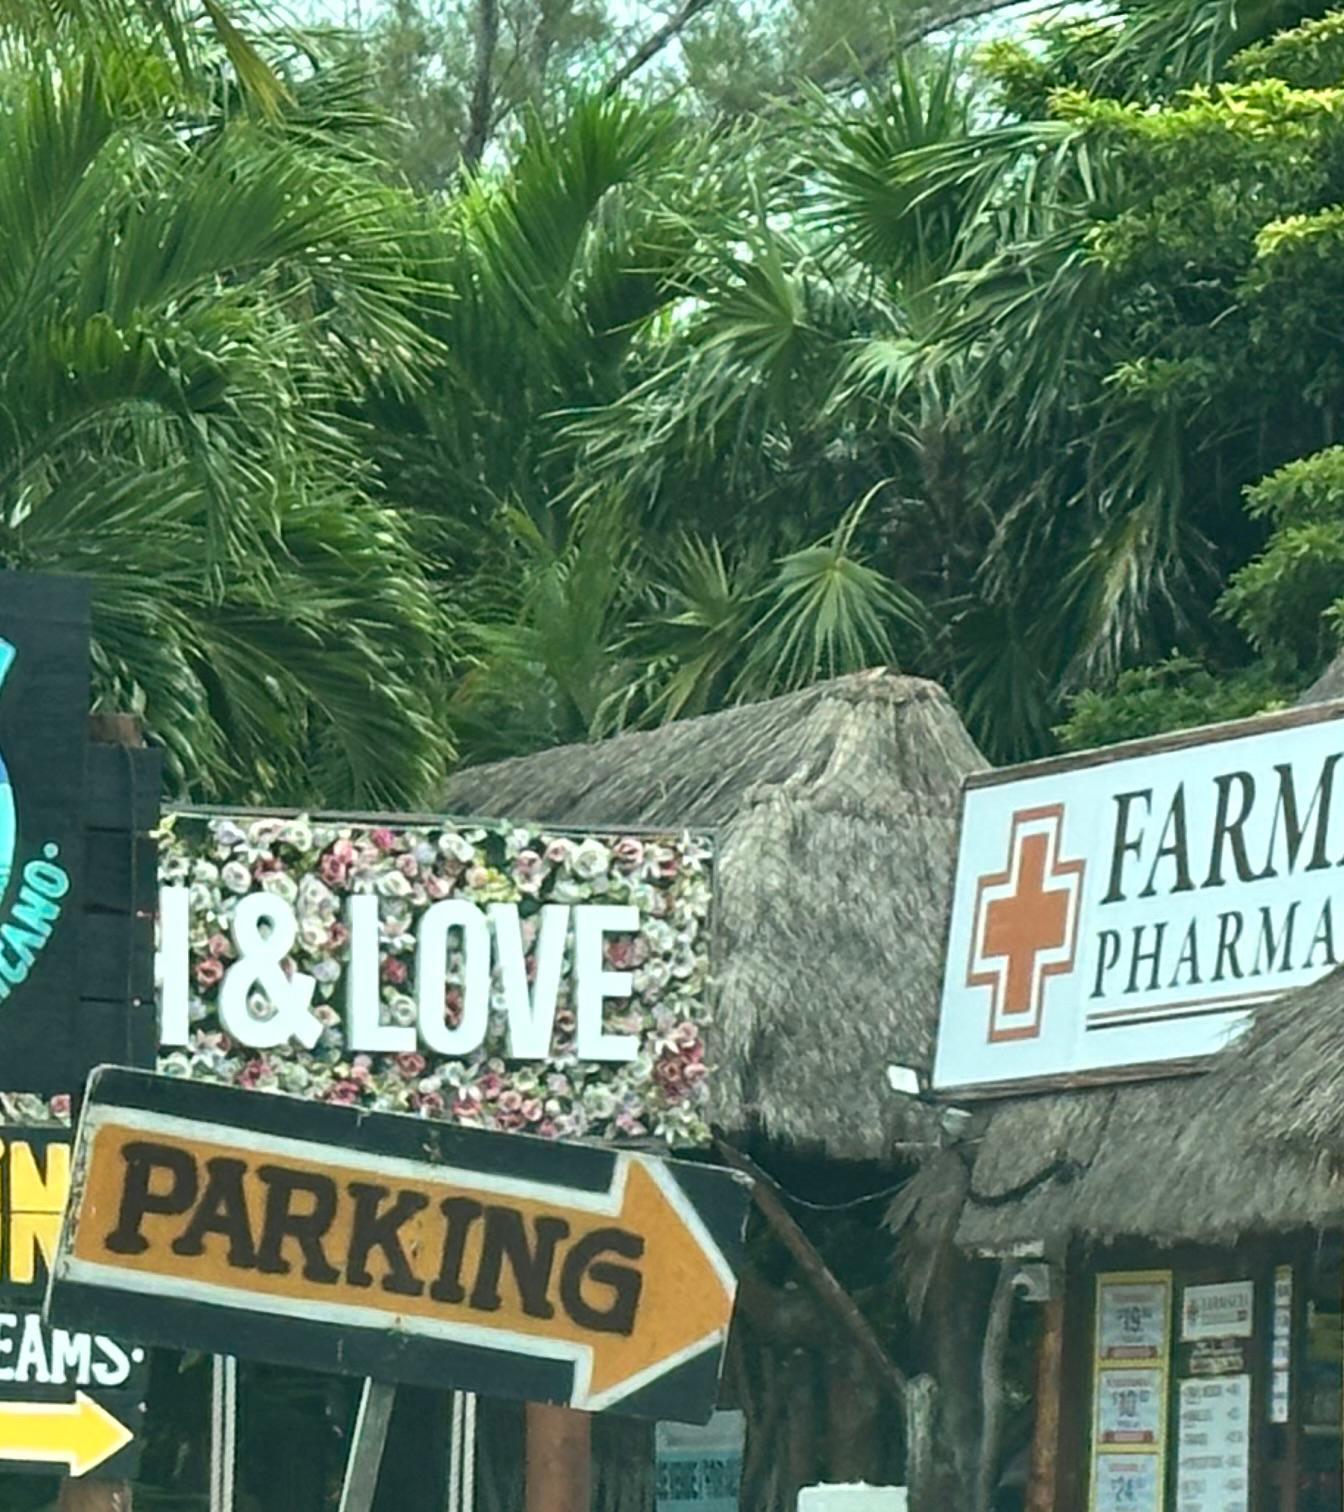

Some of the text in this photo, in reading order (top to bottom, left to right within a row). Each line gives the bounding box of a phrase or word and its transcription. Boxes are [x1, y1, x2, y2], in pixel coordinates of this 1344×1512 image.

[218, 891, 323, 1051] &
[346, 895, 641, 1062] LOVE
[104, 1141, 646, 1337] PARKING
